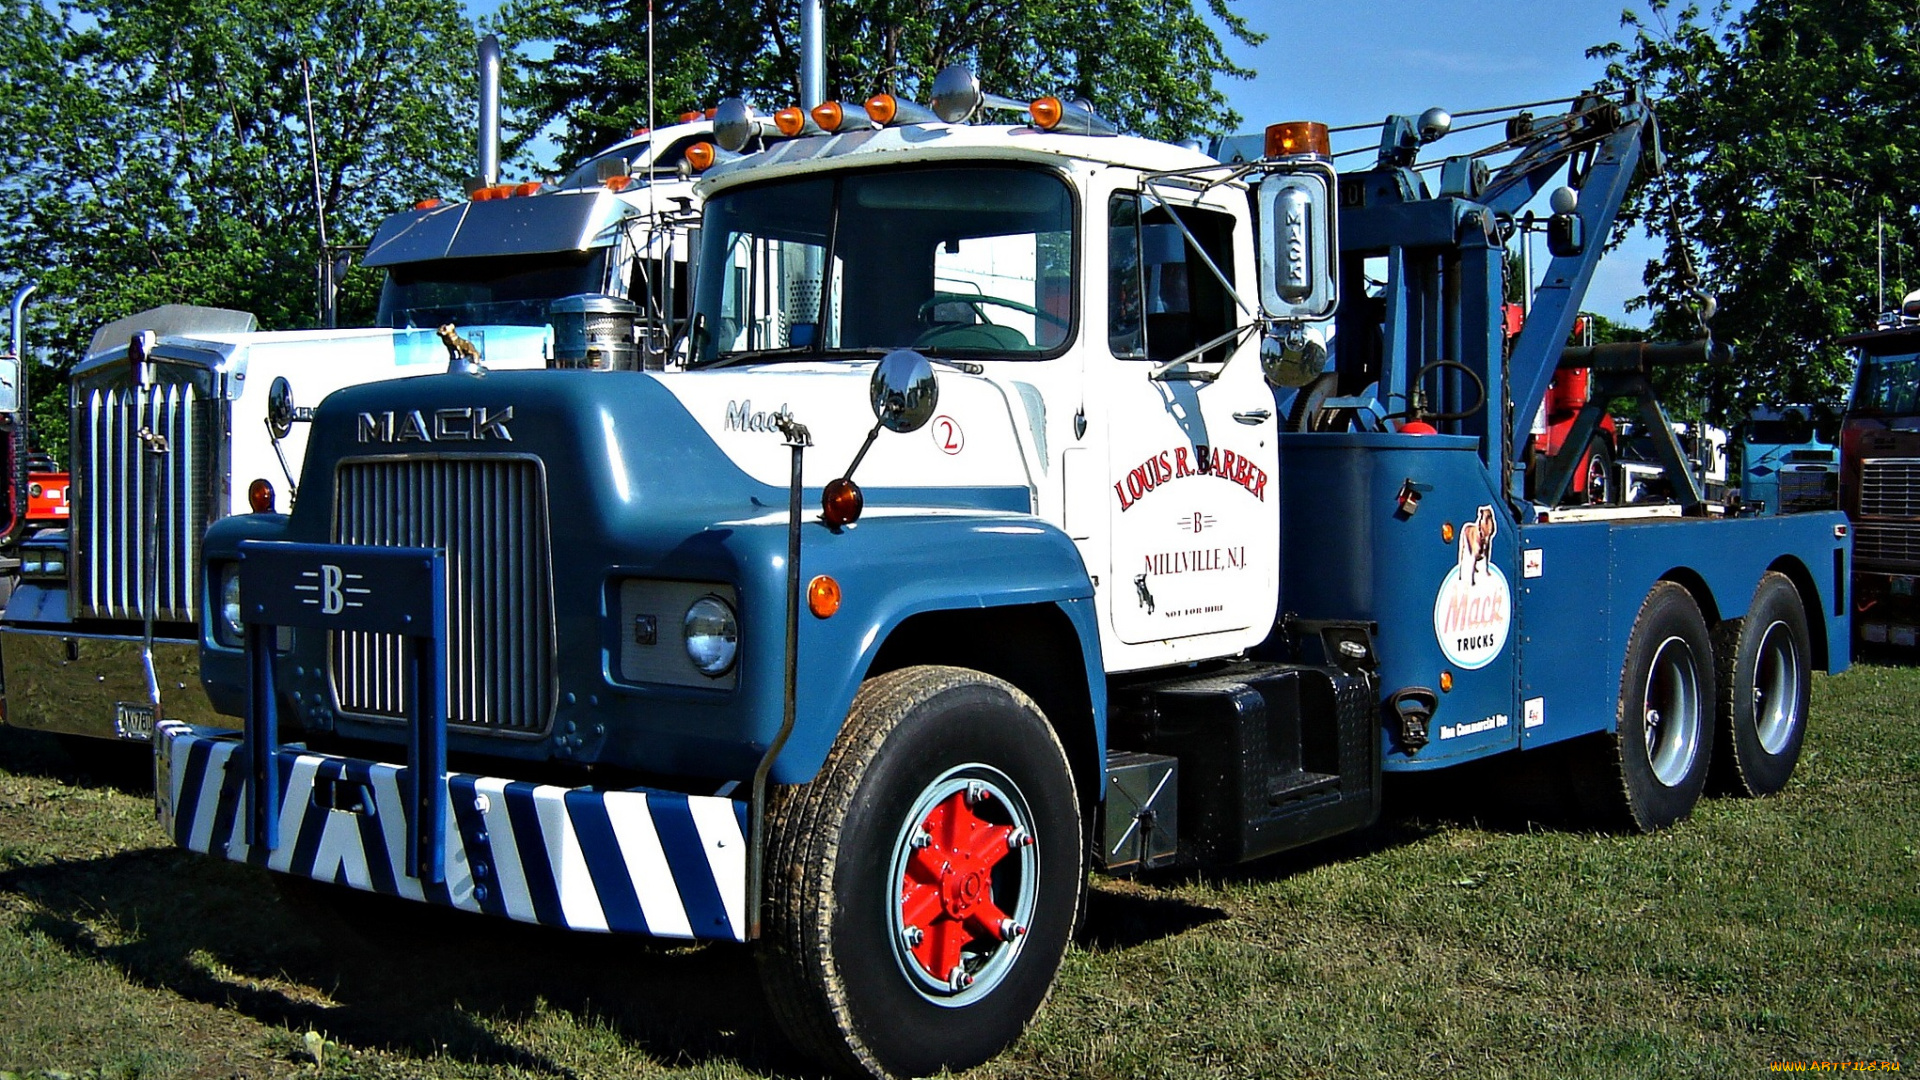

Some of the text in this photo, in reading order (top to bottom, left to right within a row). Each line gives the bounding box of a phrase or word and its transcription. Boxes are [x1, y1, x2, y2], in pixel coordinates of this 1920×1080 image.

[1286, 211, 1301, 280] MACK
[357, 405, 515, 443] MACK
[941, 421, 958, 449] 2
[1114, 446, 1268, 512] LOUIS R. BARBER
[1193, 512, 1202, 533] B
[1145, 546, 1247, 576] MILLVILLE, N.J.
[321, 564, 345, 615] B
[1444, 585, 1504, 634] Mack
[1457, 634, 1494, 651] TRUCKS
